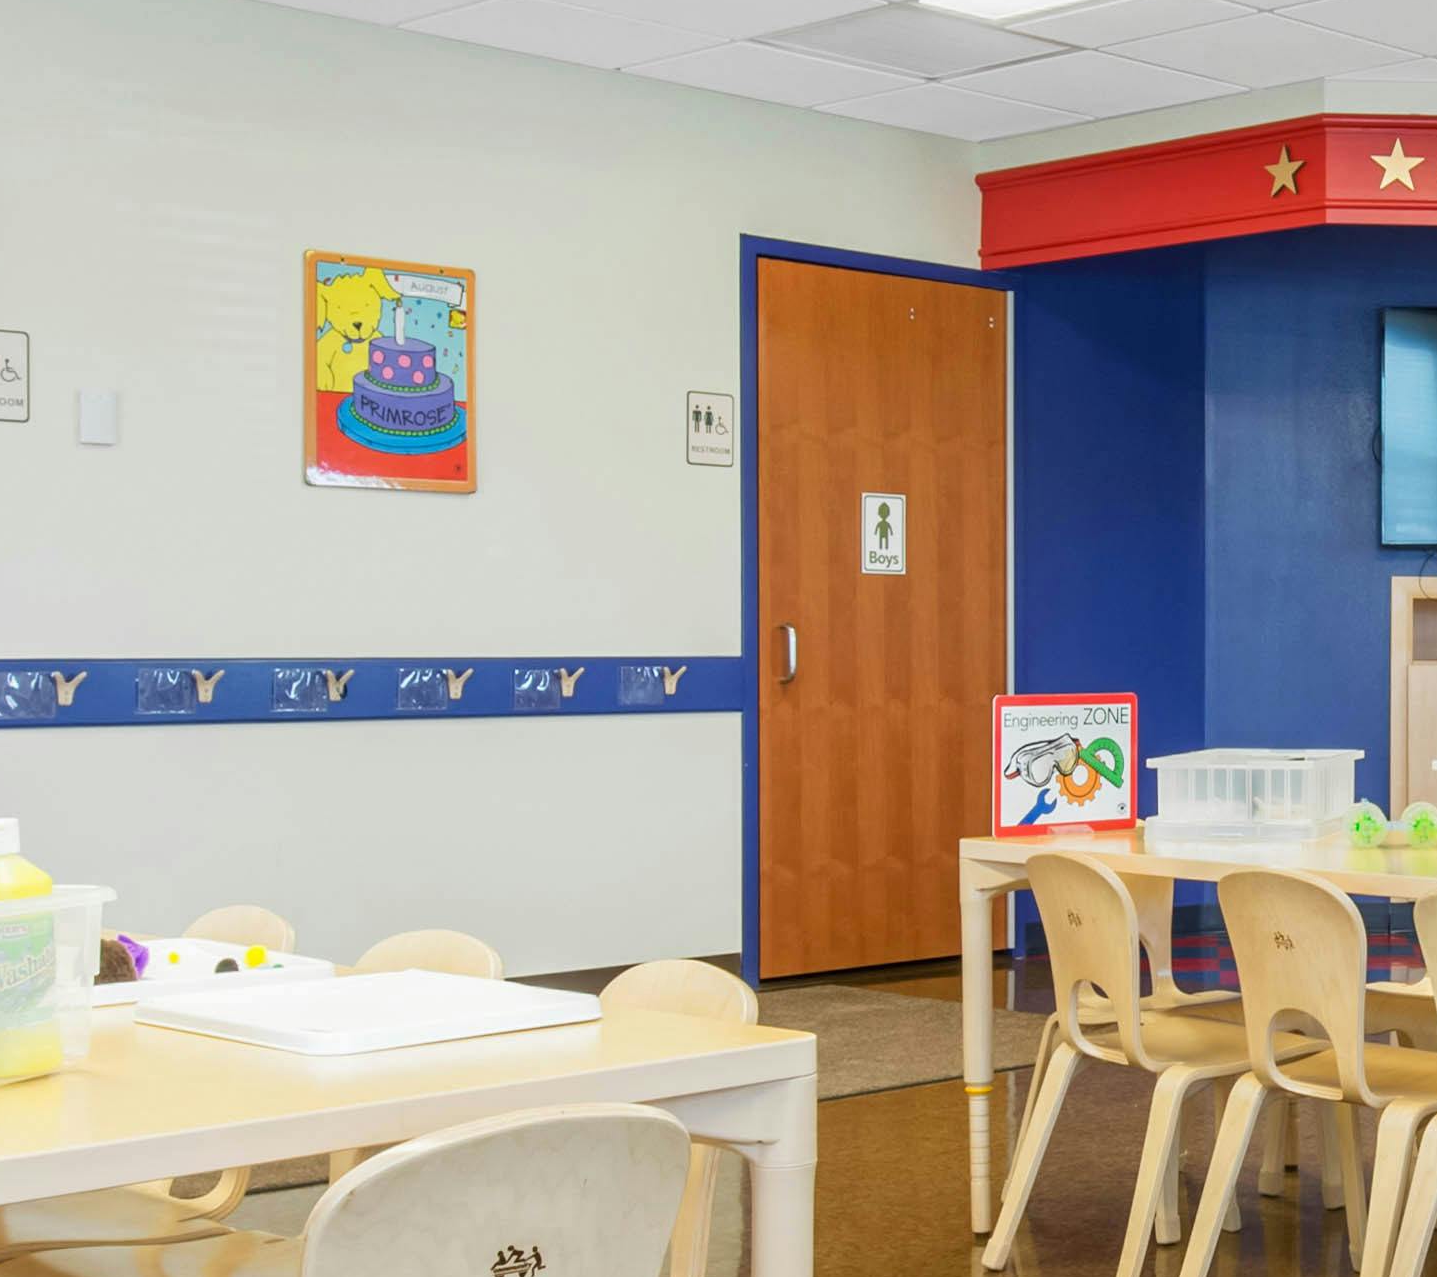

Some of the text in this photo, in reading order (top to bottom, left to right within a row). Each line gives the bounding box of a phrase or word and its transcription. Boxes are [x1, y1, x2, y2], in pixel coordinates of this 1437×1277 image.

[869, 550, 900, 568] Boys
[1003, 706, 1130, 732] Engineering ZONE
